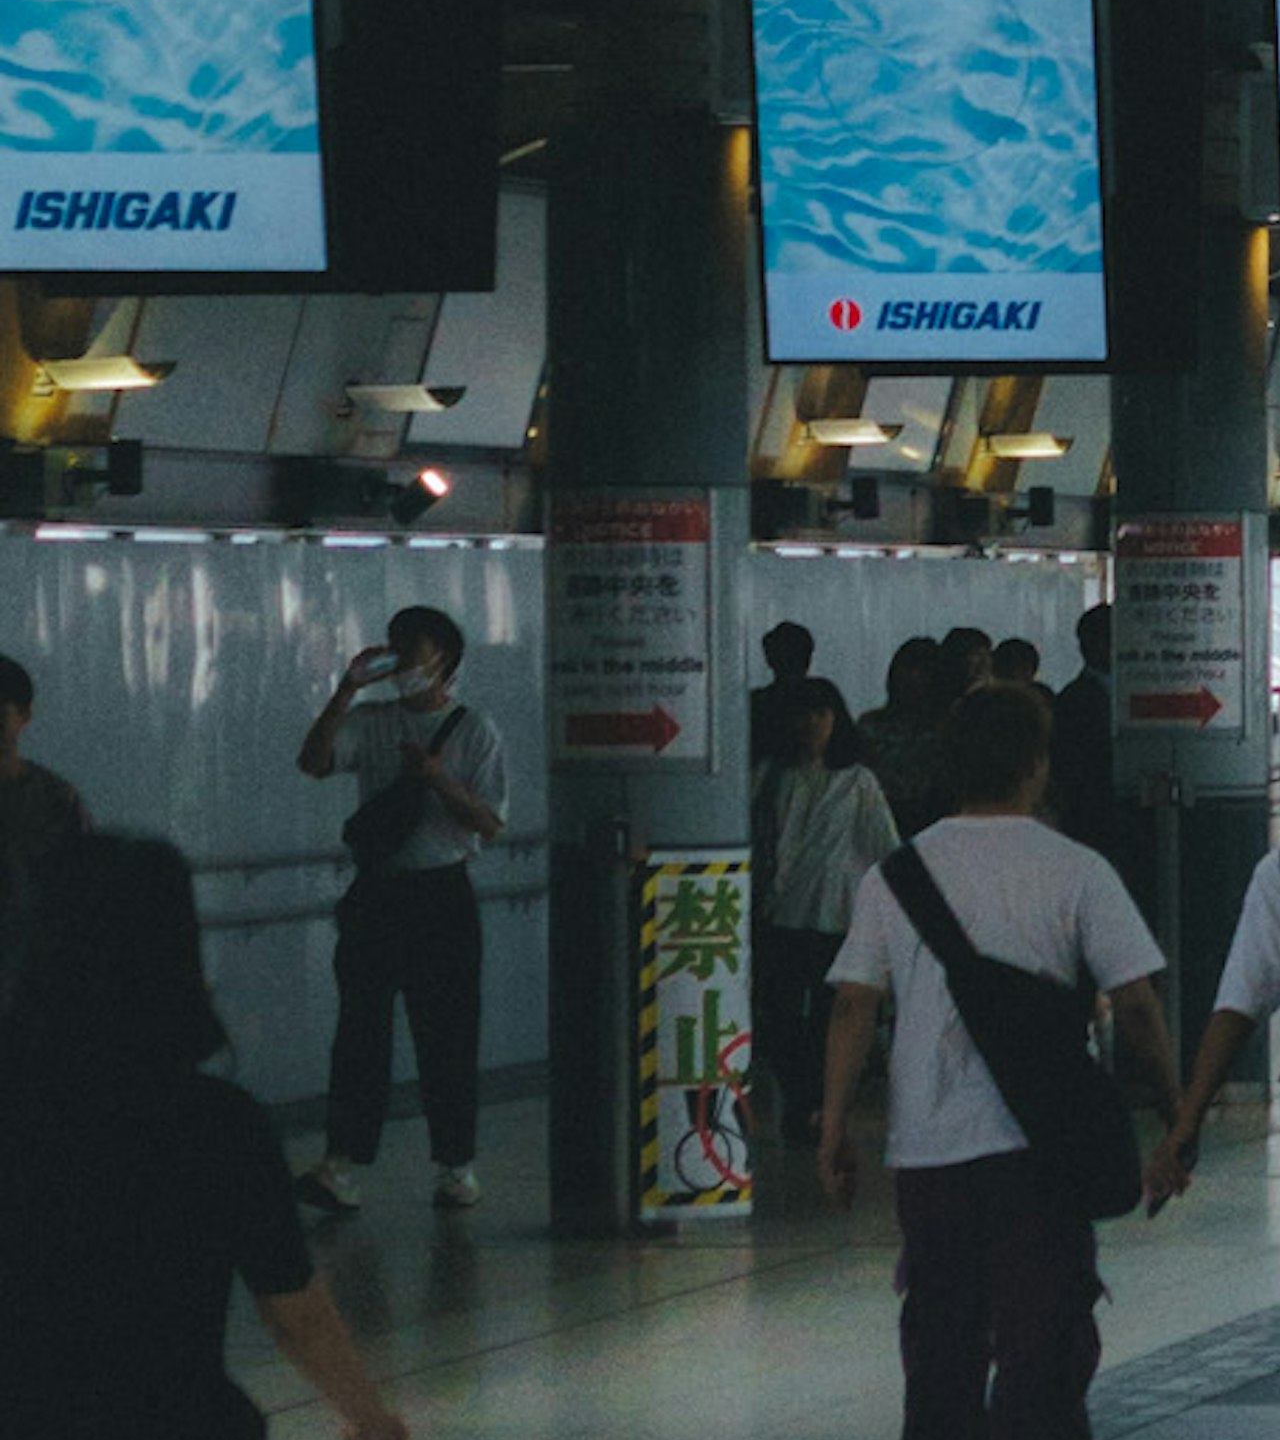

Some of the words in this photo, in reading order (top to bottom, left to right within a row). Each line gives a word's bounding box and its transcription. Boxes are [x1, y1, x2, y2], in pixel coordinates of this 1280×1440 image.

[14, 190, 238, 231] ISHIGAKI
[876, 300, 1042, 332] ISHIGAKI
[656, 878, 743, 1088] 禁止
